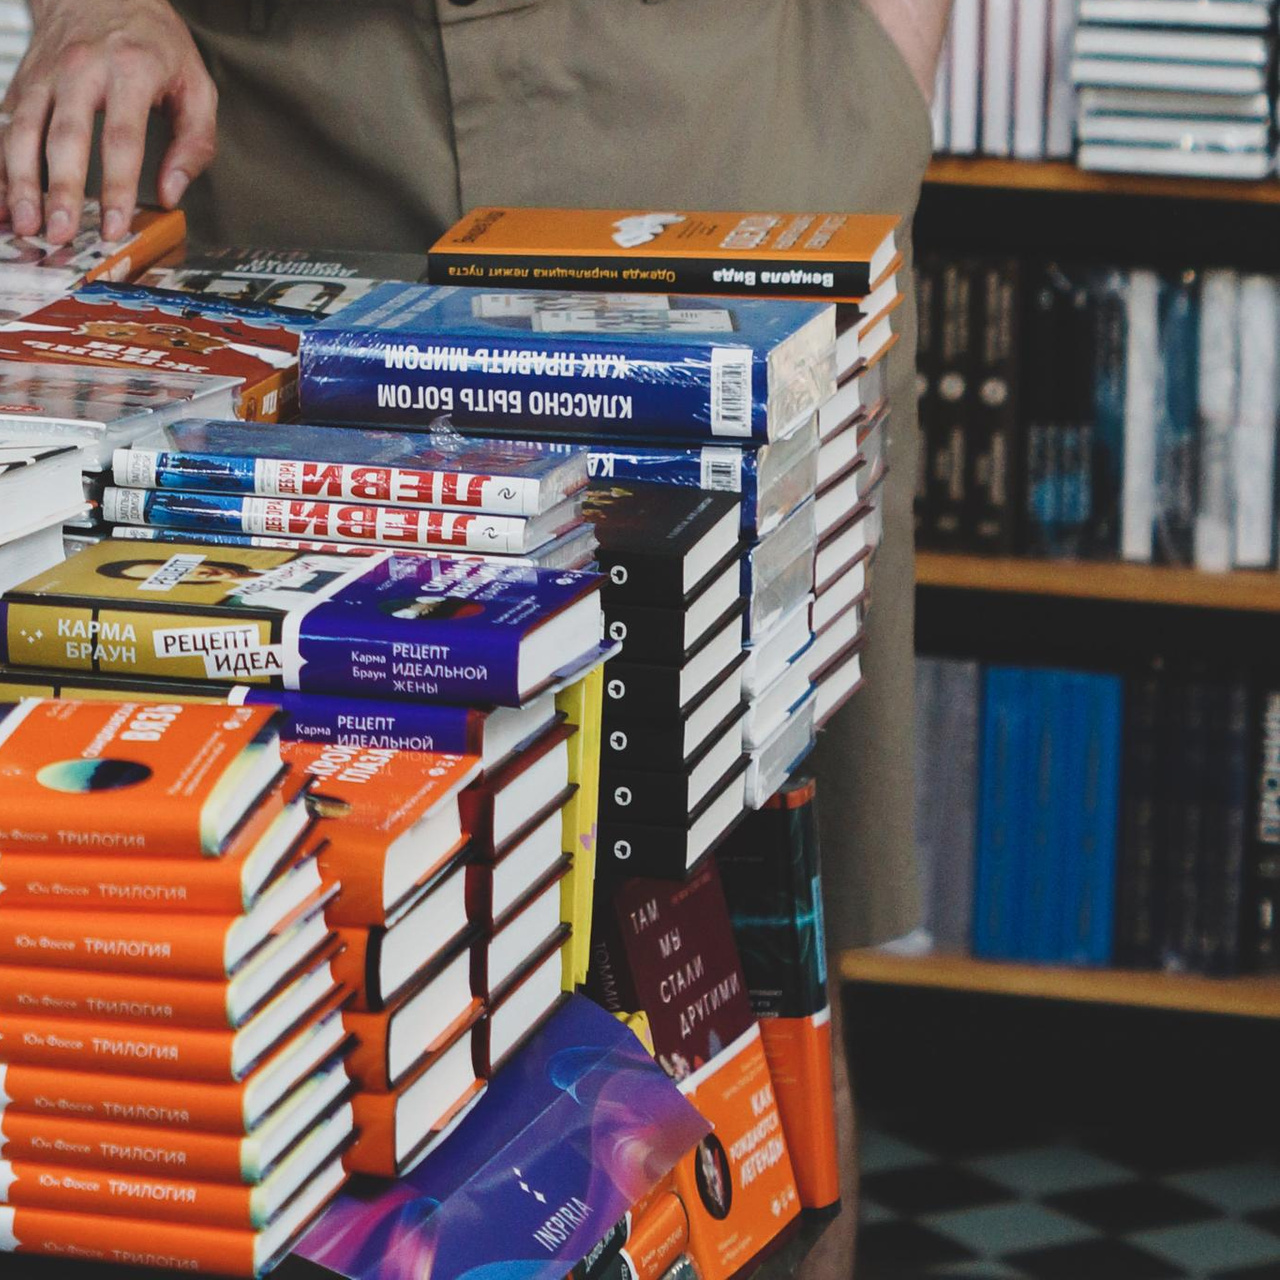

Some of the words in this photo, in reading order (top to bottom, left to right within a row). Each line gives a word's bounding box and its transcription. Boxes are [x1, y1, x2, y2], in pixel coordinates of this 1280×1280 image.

[448, 266, 484, 278] пуста
[489, 267, 529, 278] лежит
[622, 268, 676, 283] Одежда
[713, 269, 756, 286] Вида
[761, 271, 834, 288] Вендела
[384, 344, 468, 371] МИРОМ
[481, 348, 574, 377] ПРАВИТЬ
[585, 352, 628, 379] КАК
[377, 383, 454, 411] БОГОМ
[464, 387, 521, 415] БЫТЬ
[528, 392, 632, 419] КЛАССНО
[586, 452, 615, 477] КА
[278, 462, 297, 495] ДЕБОРА
[302, 463, 491, 508] ЛЕВИ
[264, 499, 284, 532] ДЕБОРА
[288, 500, 477, 546] ЛЕВИ
[57, 618, 138, 643] КАРМА
[163, 629, 254, 655] РЕЦЕПТ
[66, 642, 137, 665] БРАУН
[214, 651, 282, 675] ИДЕА
[351, 651, 387, 666] Карма
[392, 643, 450, 662] РЕЦЕПТ
[352, 666, 387, 681] Браун
[392, 662, 488, 681] ИДЕАЛЬНОЙ
[393, 679, 439, 695] ЖЕНЫ
[120, 704, 183, 741] ВЯЗЬ
[295, 723, 331, 737] Карма
[337, 715, 396, 731] РЕЦЕПТ
[337, 734, 434, 751] ИДЕАЛЬНОЙ
[58, 830, 146, 849] ТРИЛОГИЯ
[98, 883, 187, 901] ТРИЛОГИЯ
[629, 898, 660, 934] ТАМ
[85, 939, 172, 959] ТРИЛОГИЯ
[658, 927, 682, 959] МЫ
[594, 942, 620, 1010] ТОММИ
[660, 954, 705, 1004] СТАЛИ
[87, 998, 173, 1018] ТРИЛОГИЯ
[678, 972, 741, 1040] ДРУГИМИ
[92, 1038, 179, 1061] ТРИЛОГИЯ
[103, 1101, 190, 1123] ТРИЛОГИЯ
[100, 1143, 187, 1164] ТРИЛОГИЯ
[740, 1134, 785, 1190] ЛЕГЕНДЫ
[109, 1180, 197, 1203] ТРИЛОГИЯ
[532, 1196, 593, 1253] INSPIRIA
[111, 1249, 199, 1271] ТРИЛОГИЯ
